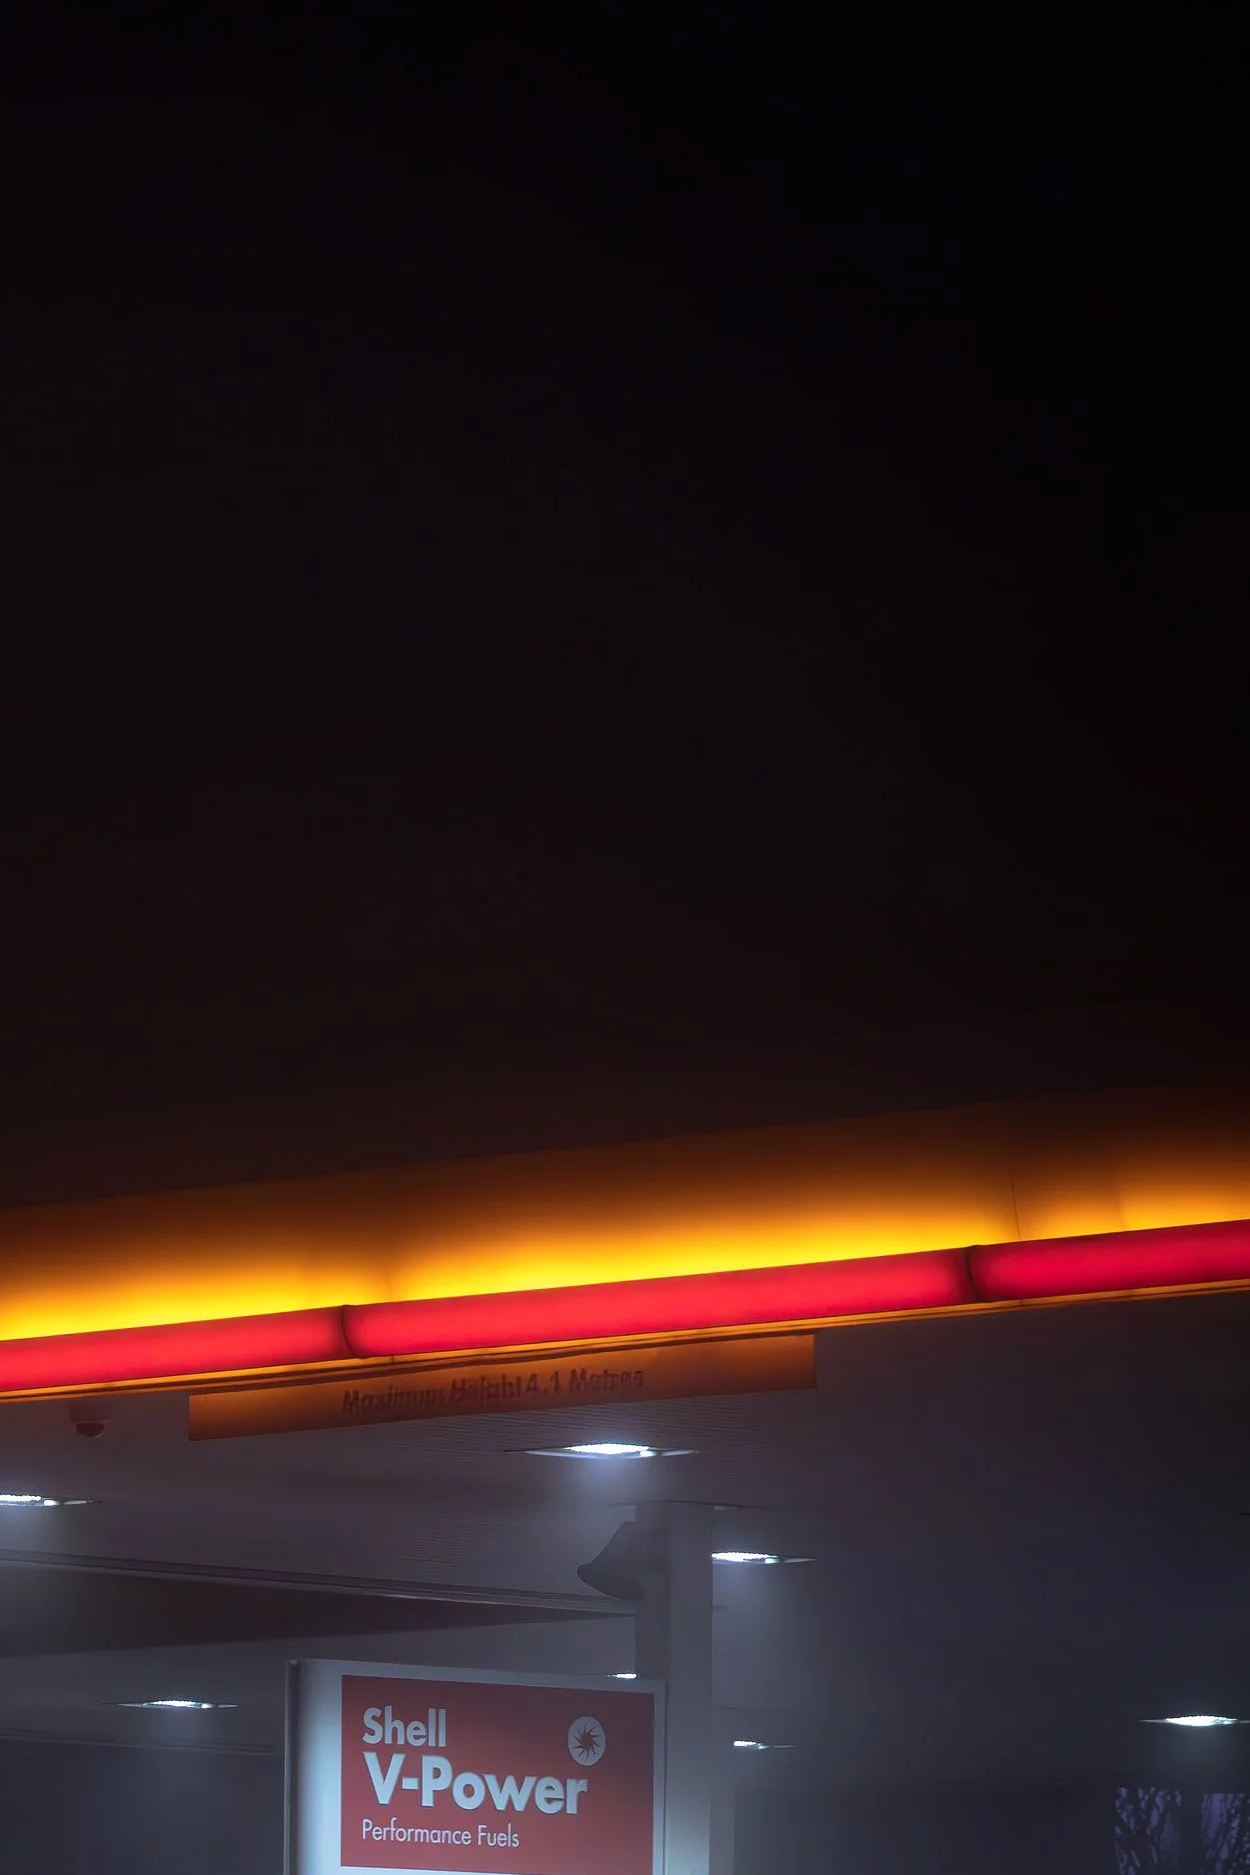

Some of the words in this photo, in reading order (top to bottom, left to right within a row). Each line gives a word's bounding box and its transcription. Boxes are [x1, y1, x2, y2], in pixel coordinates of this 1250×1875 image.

[362, 1705, 447, 1748] Shell
[362, 1751, 588, 1815] V-Power
[361, 1817, 472, 1847] Performance
[477, 1824, 520, 1848] Fuels
